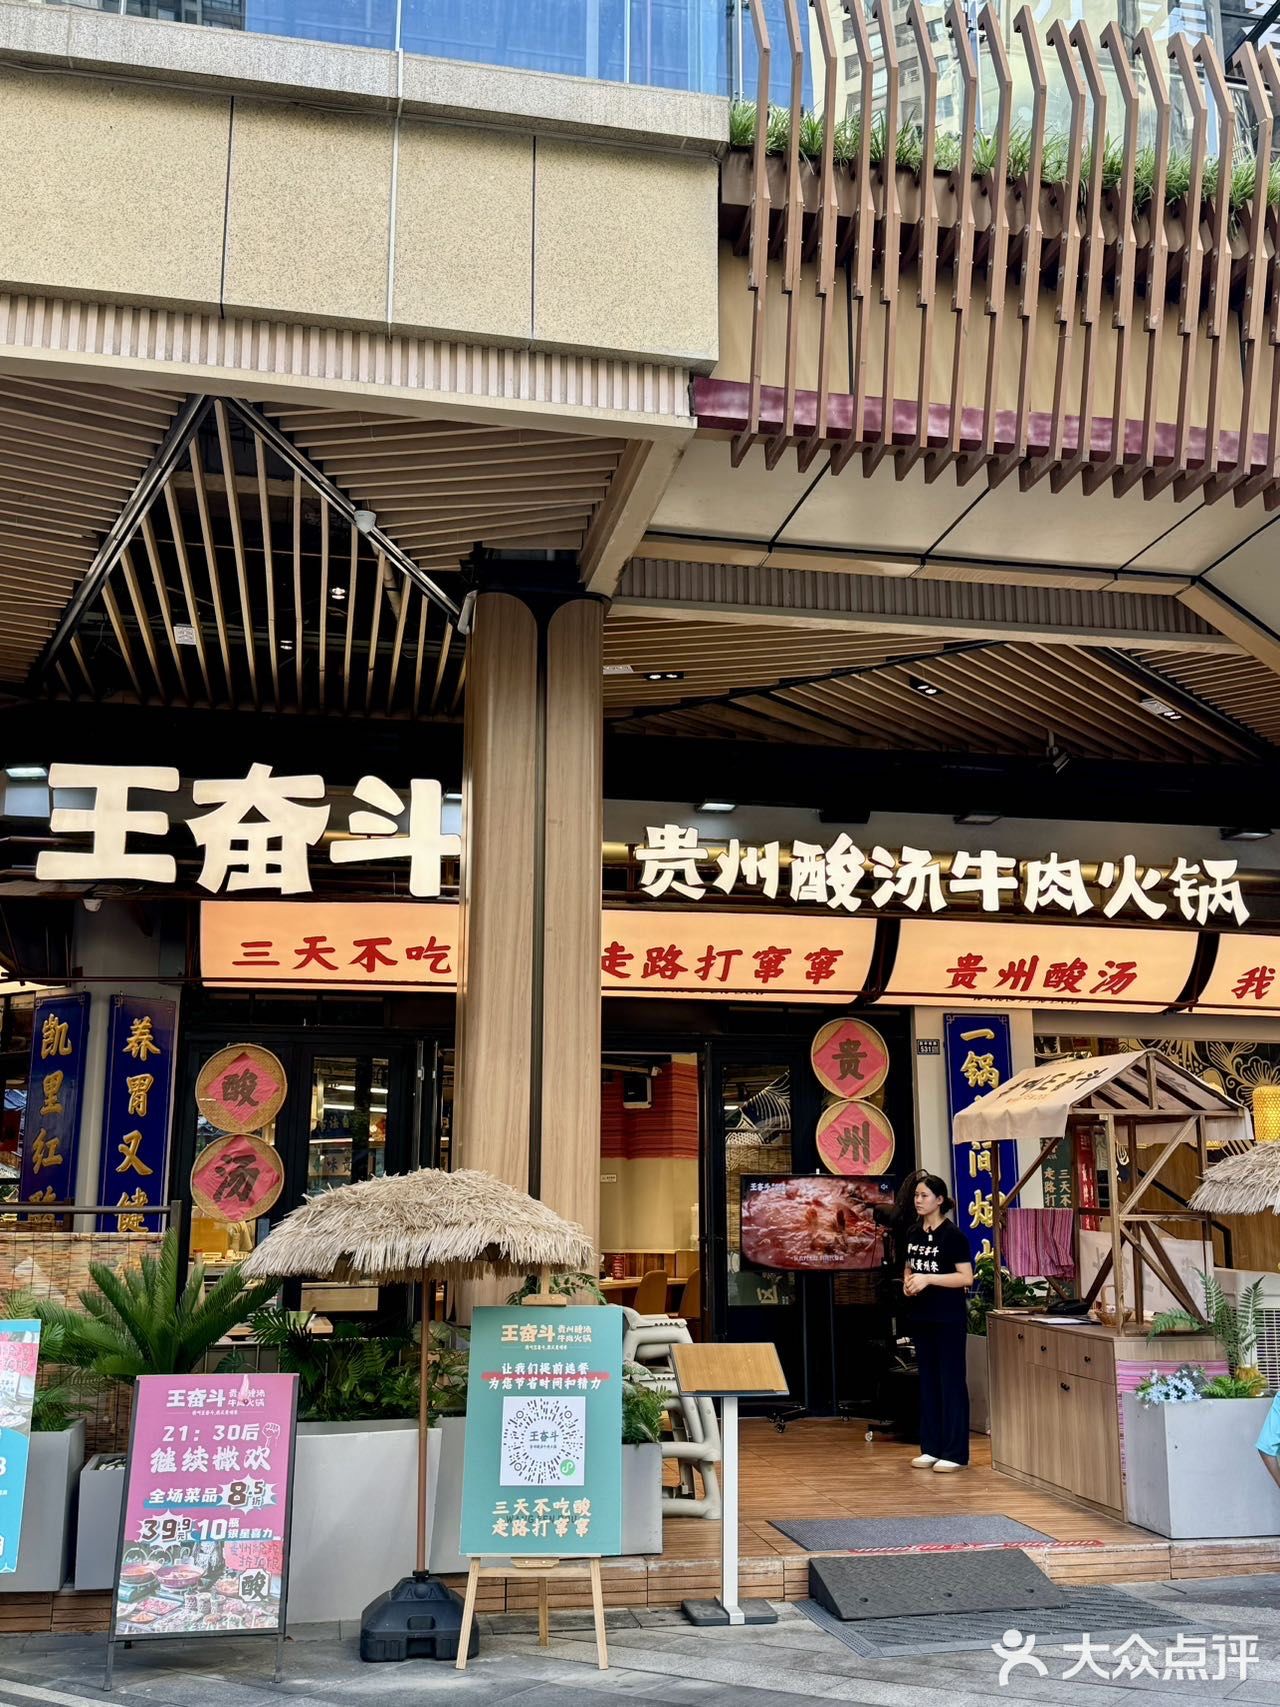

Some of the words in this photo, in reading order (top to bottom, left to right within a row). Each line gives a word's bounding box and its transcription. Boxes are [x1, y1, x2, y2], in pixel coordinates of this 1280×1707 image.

[35, 762, 461, 898] 王奋斗
[635, 823, 1250, 926] 贵州酸汤牛肉火锅
[231, 935, 452, 975] 三天不吃
[945, 952, 1138, 995] 贵州酸汤
[1231, 965, 1276, 1000] 我
[832, 1038, 867, 1081] 贵
[221, 1068, 259, 1108] 酸
[836, 1120, 870, 1165] 州
[213, 1153, 260, 1204] 汤
[501, 1324, 556, 1342] 王奋斗
[166, 1388, 226, 1408] 王奋斗
[488, 1376, 602, 1390] 为您节省时间和精力
[150, 1445, 272, 1474] 继续撒欢
[148, 1487, 218, 1504] 全场菜品
[492, 1497, 592, 1517] 三天不吃酸
[241, 1570, 267, 1601] 酸
